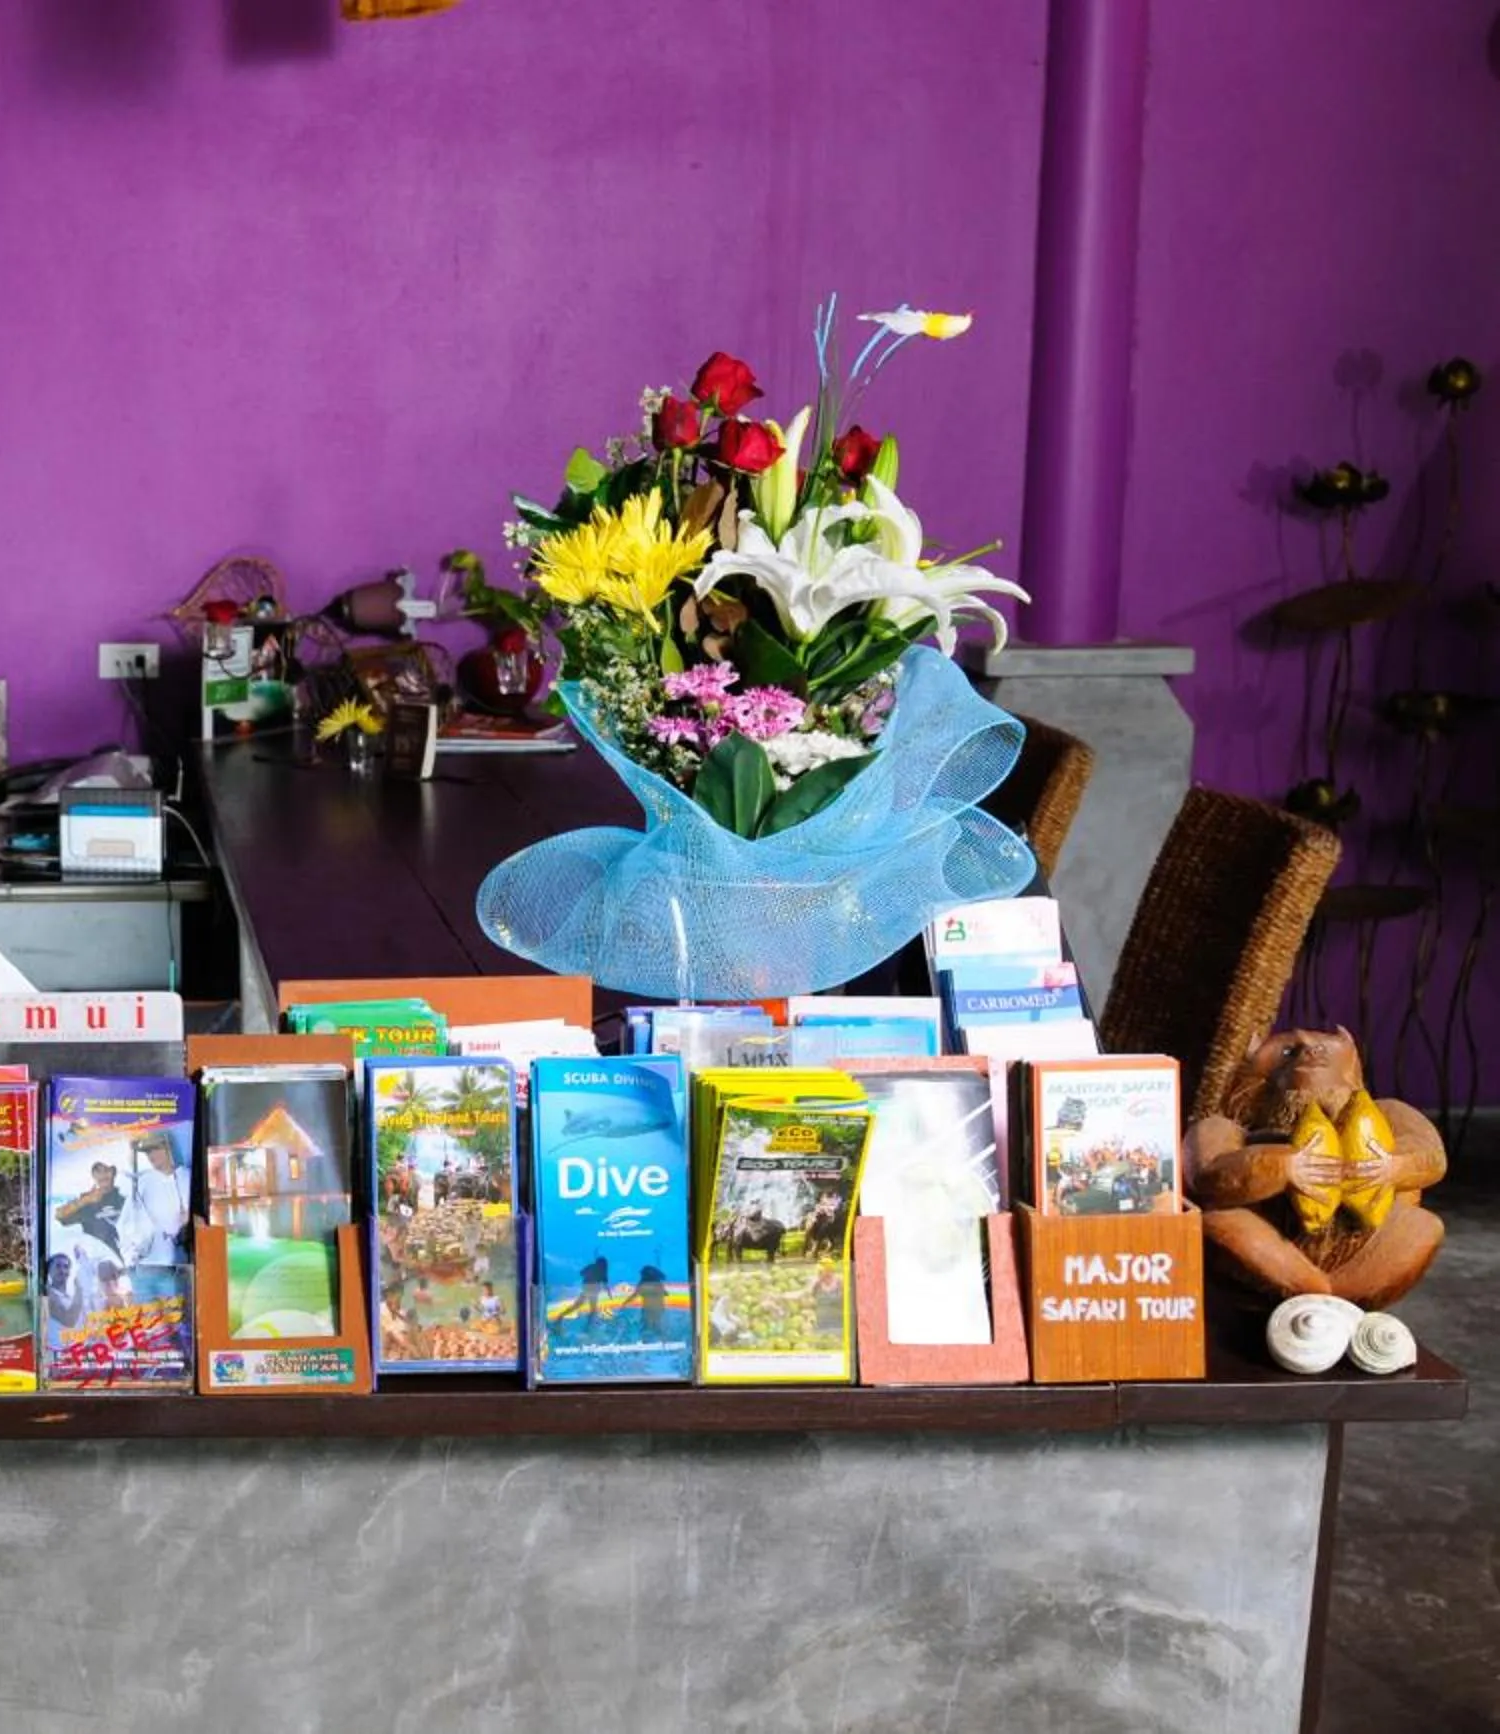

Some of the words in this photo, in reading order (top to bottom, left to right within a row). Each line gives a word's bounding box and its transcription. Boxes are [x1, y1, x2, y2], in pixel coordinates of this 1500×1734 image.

[375, 1026, 437, 1043] TOUR
[563, 1071, 609, 1086] SCUBA
[558, 1157, 669, 1199] Dive
[1064, 1253, 1173, 1285] MAJOR
[1041, 1296, 1127, 1322] SAFARI
[1136, 1296, 1197, 1321] TOUR
